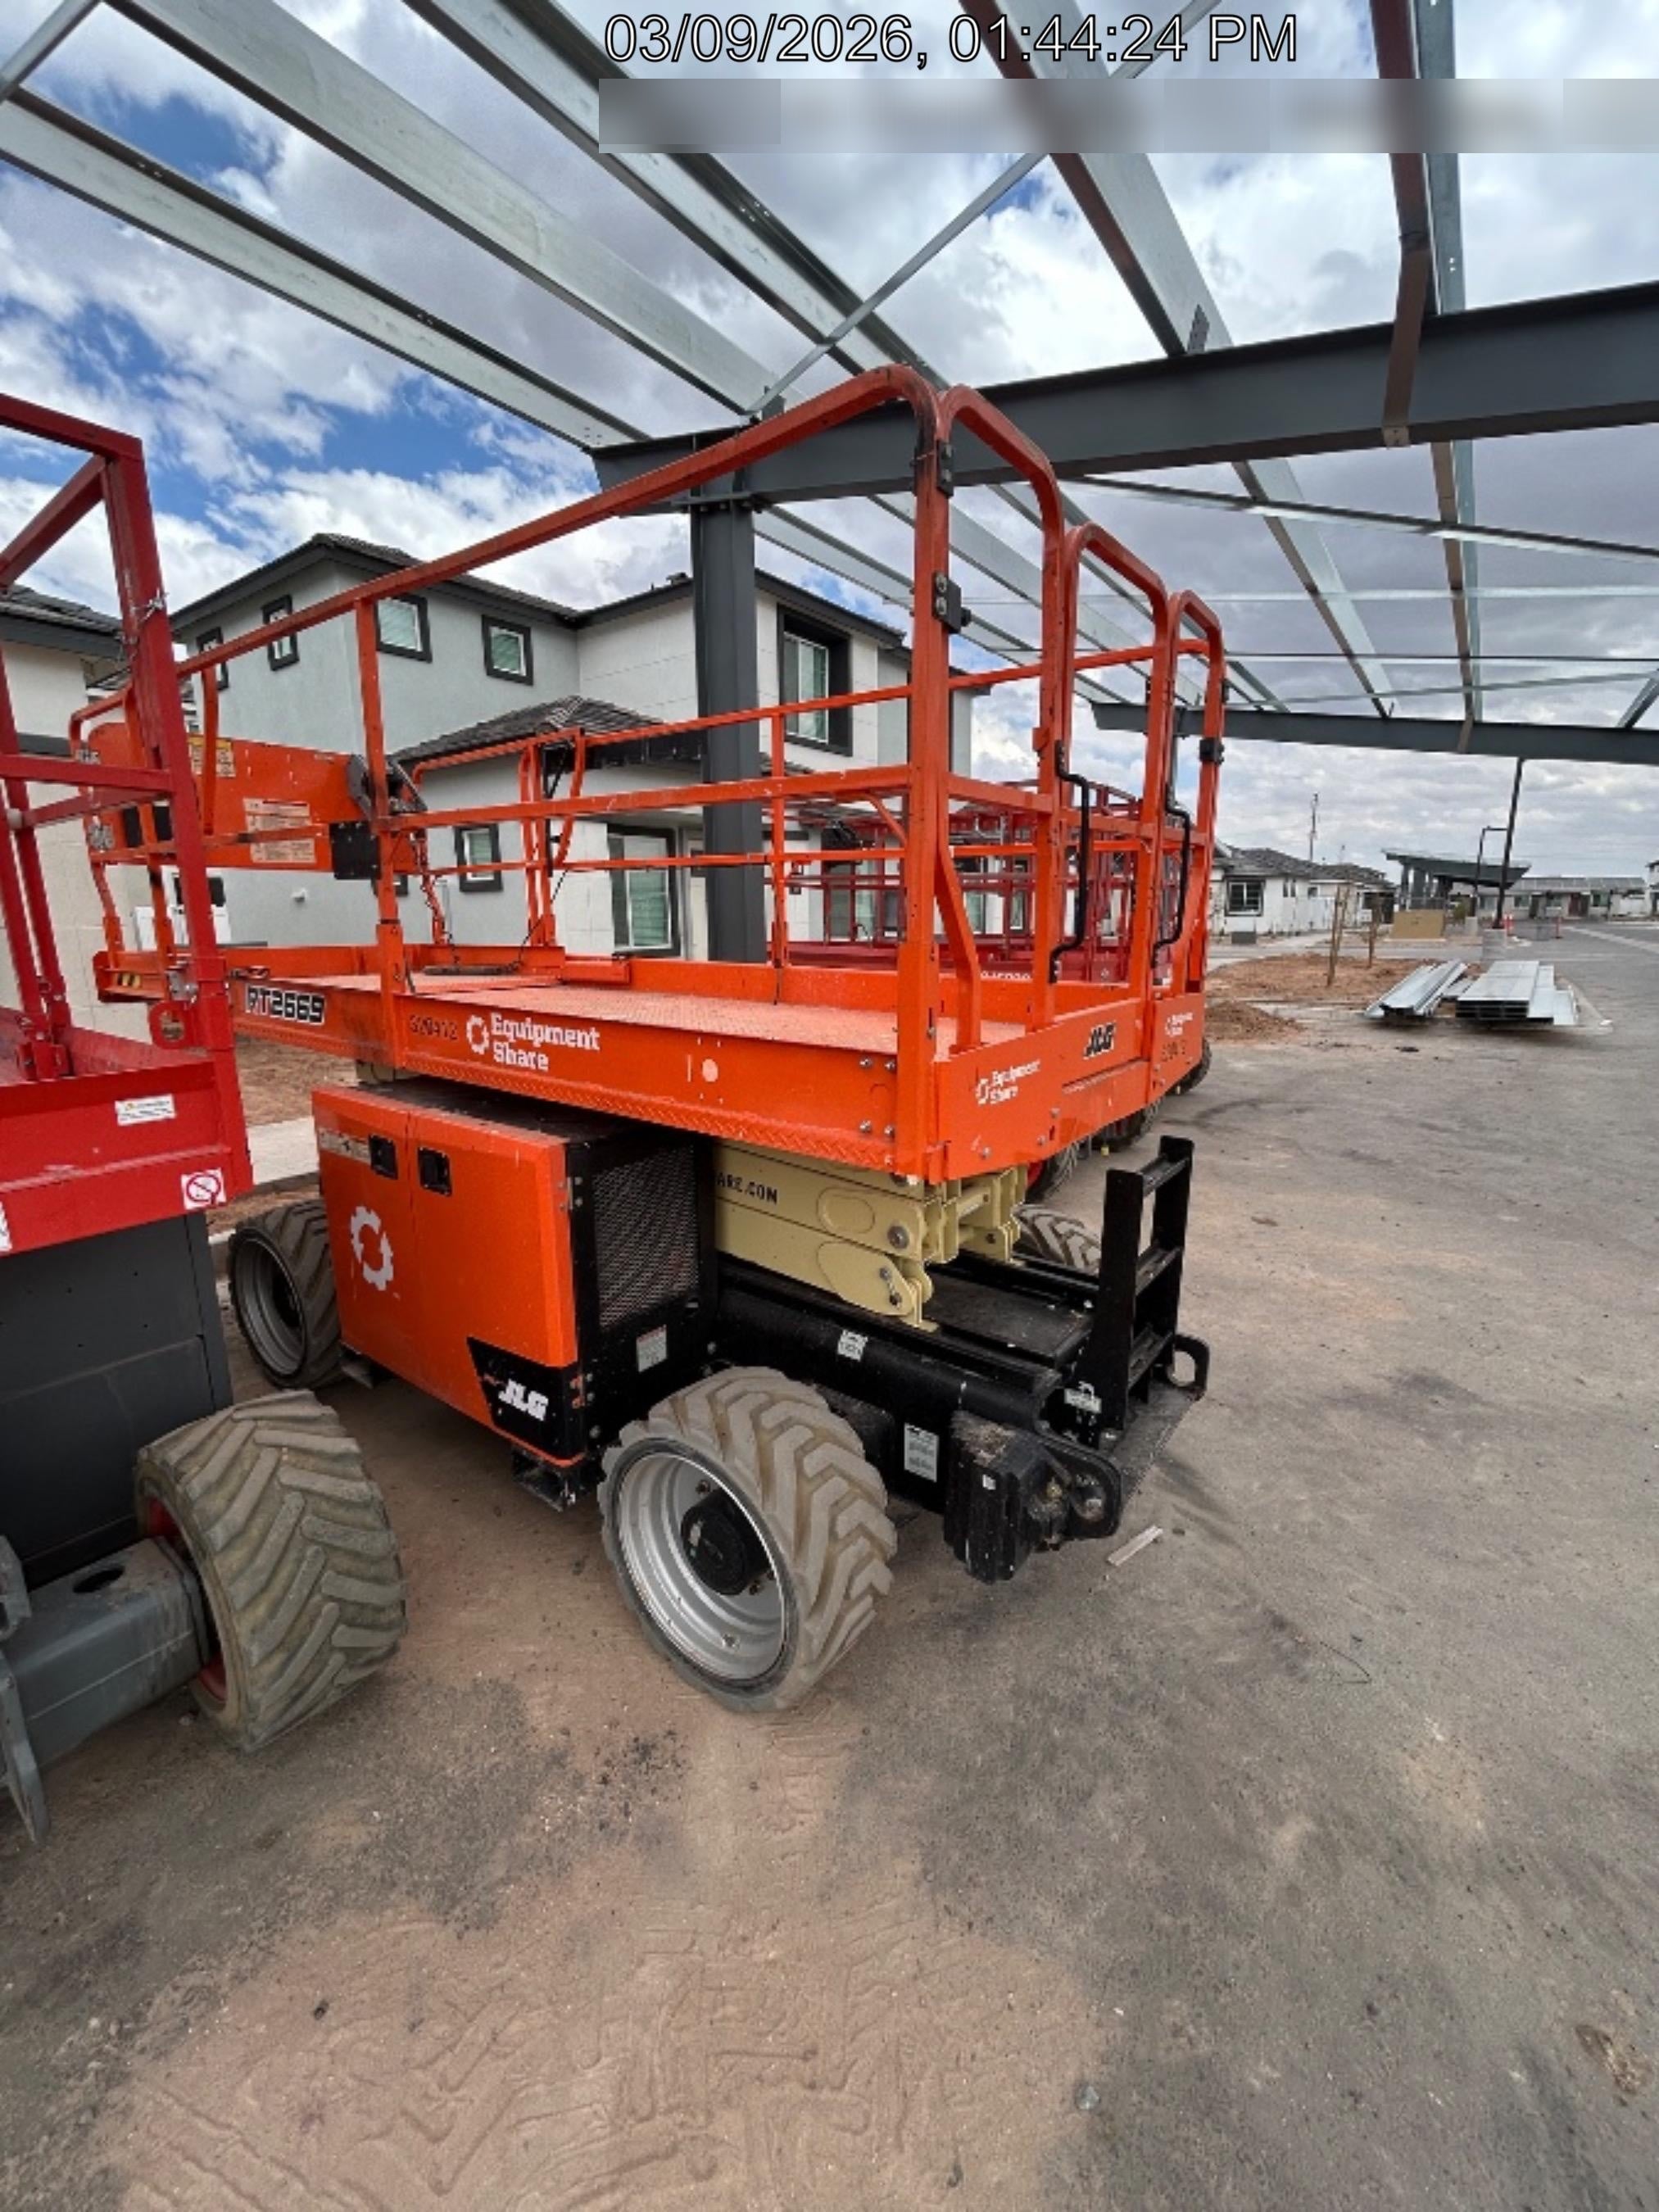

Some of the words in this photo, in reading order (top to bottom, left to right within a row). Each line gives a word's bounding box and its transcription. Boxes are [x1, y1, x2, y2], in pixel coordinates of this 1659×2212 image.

[247, 985, 325, 1026] RT2669
[490, 1012, 601, 1051] Equipment
[493, 1040, 549, 1072] Share
[498, 1378, 550, 1422] JLG
